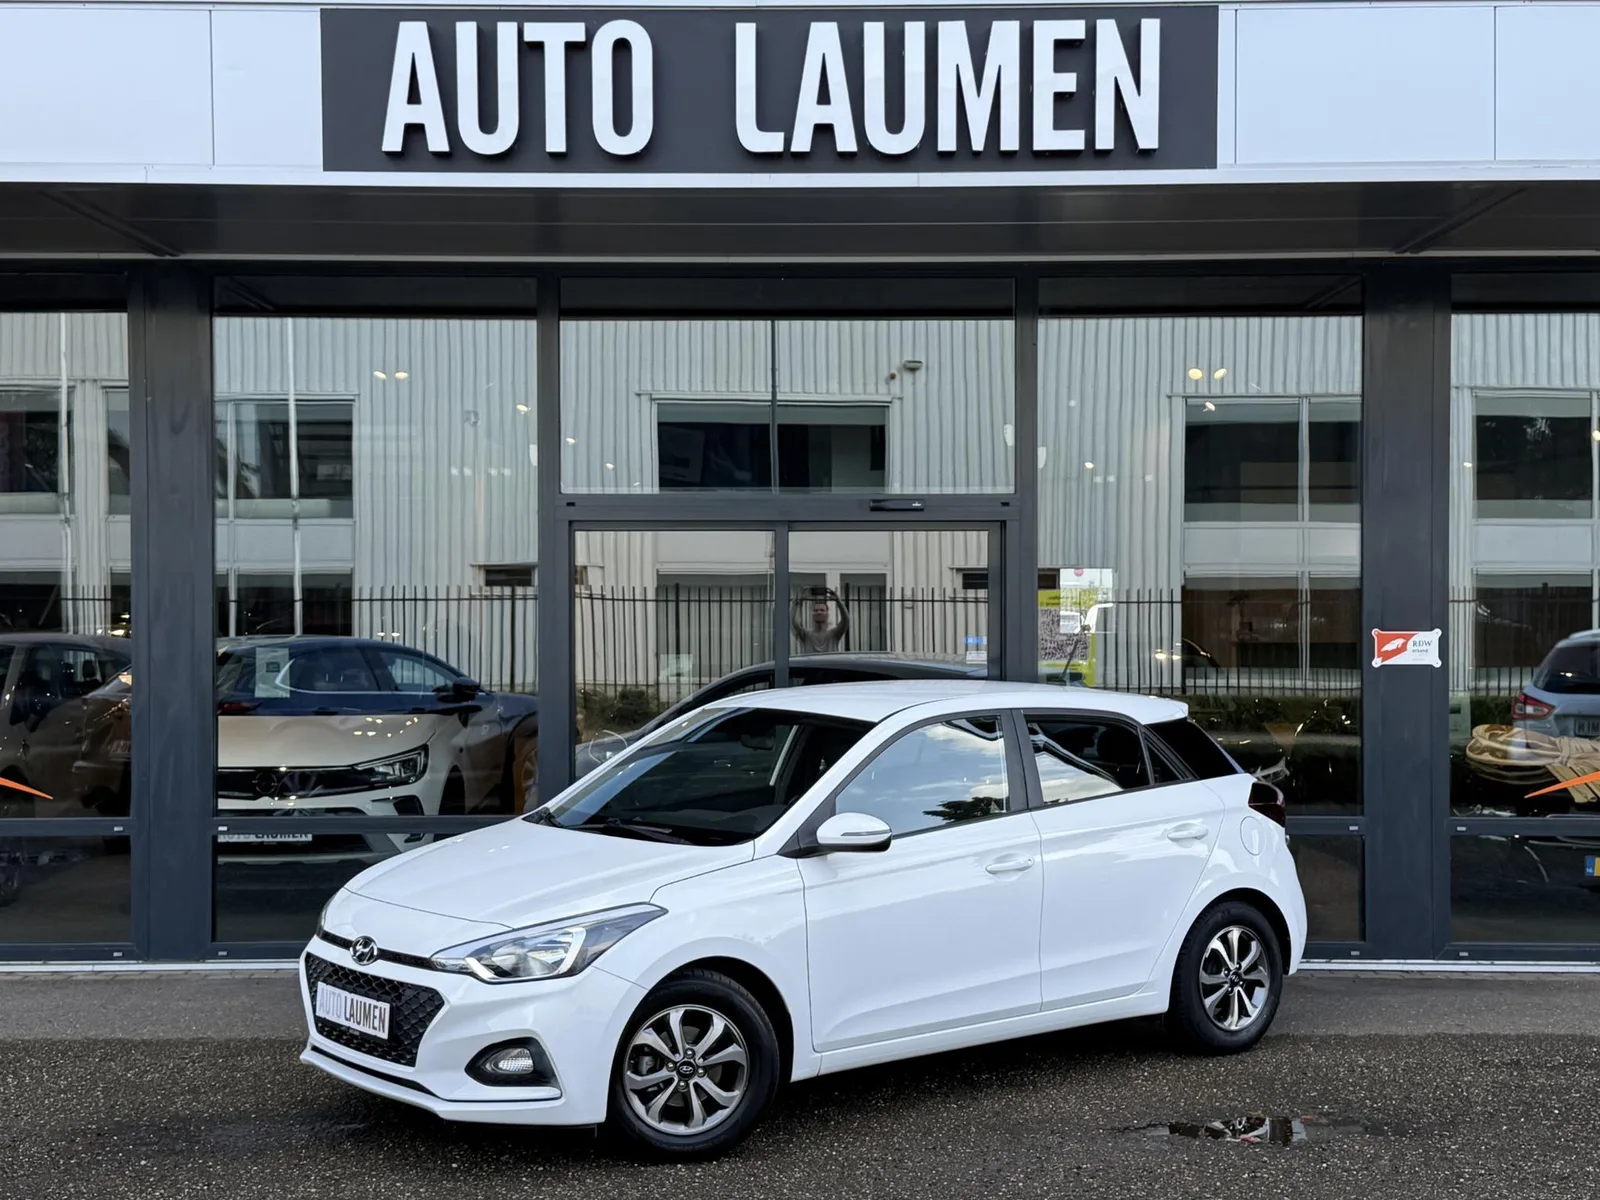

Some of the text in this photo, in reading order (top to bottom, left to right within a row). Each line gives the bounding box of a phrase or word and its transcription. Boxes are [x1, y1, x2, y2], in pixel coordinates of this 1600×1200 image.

[382, 18, 1160, 155] AUTO LAUMEN
[319, 988, 387, 1034] AUTO LAUMEN
